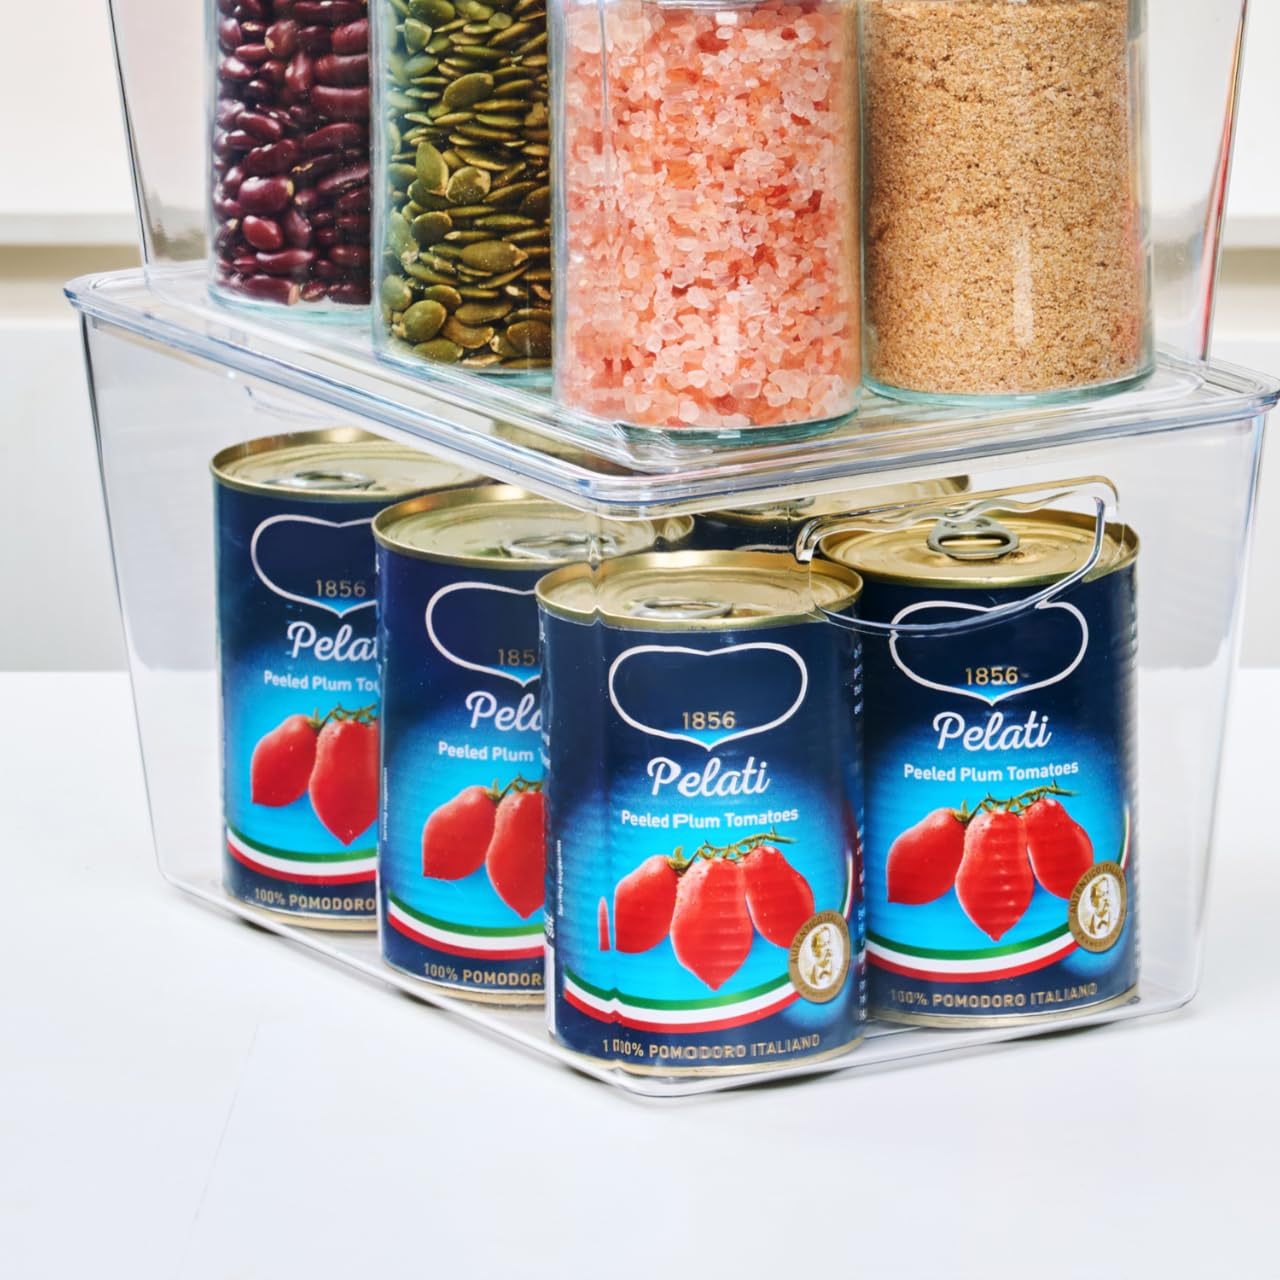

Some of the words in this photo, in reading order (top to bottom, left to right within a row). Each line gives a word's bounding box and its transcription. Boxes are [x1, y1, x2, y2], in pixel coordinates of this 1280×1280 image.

[316, 580, 366, 598] 1856
[497, 649, 537, 666] 185
[263, 670, 308, 690] Peeled
[312, 675, 352, 692] Plum
[966, 666, 1018, 685] 1856
[465, 690, 543, 732] Pela
[682, 712, 736, 730] 1856
[933, 711, 1051, 751] Pelati
[438, 741, 487, 760] Peeled
[493, 744, 534, 762] Plum
[647, 756, 770, 798] Pelati
[904, 764, 955, 781] Peeled
[961, 767, 1003, 782] Plum
[1007, 762, 1079, 781] Tomatoes
[621, 810, 669, 829] Peeled
[673, 813, 721, 830] Plum
[725, 807, 799, 828] Tomatoes
[255, 888, 285, 905] 100%
[289, 894, 376, 911] POMODORO
[424, 962, 457, 981] 100%
[463, 969, 544, 986] POMODOR
[891, 989, 928, 1006] 100%
[932, 993, 1025, 1008] POMODORO
[1030, 982, 1097, 1005] ITALIANO
[649, 1044, 746, 1060] POMODORO
[751, 1034, 820, 1056] ITALIANO
